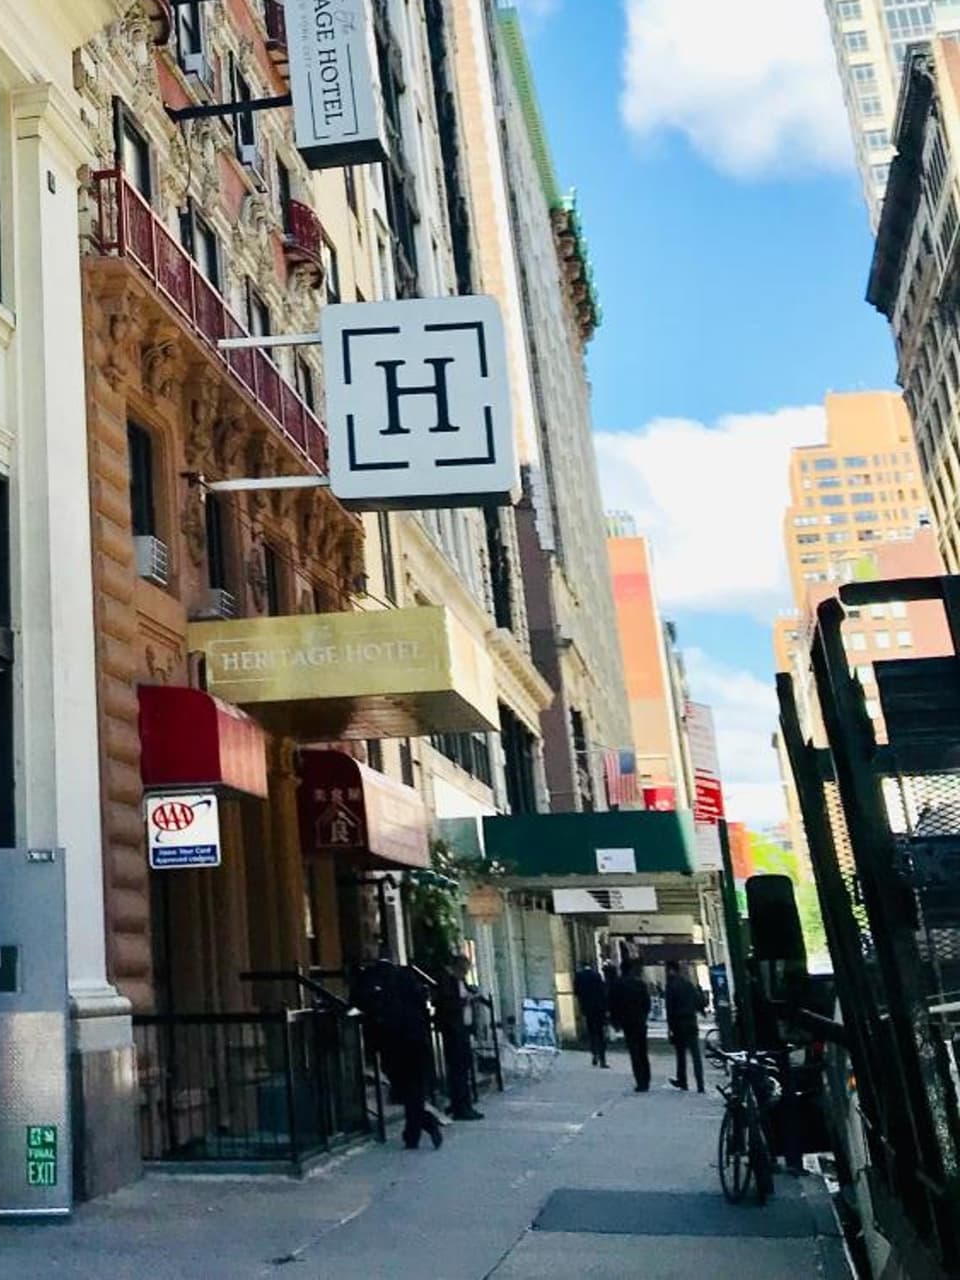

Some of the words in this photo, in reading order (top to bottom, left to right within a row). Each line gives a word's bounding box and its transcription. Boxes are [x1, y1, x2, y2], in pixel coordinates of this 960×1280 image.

[318, 48, 343, 126] HOTEL
[375, 356, 461, 436] H
[221, 644, 339, 671] HERITAGE
[345, 639, 419, 664] HOTEL
[154, 802, 193, 831] AAA
[29, 1148, 55, 1160] FINAL
[29, 1161, 55, 1185] EXIT
